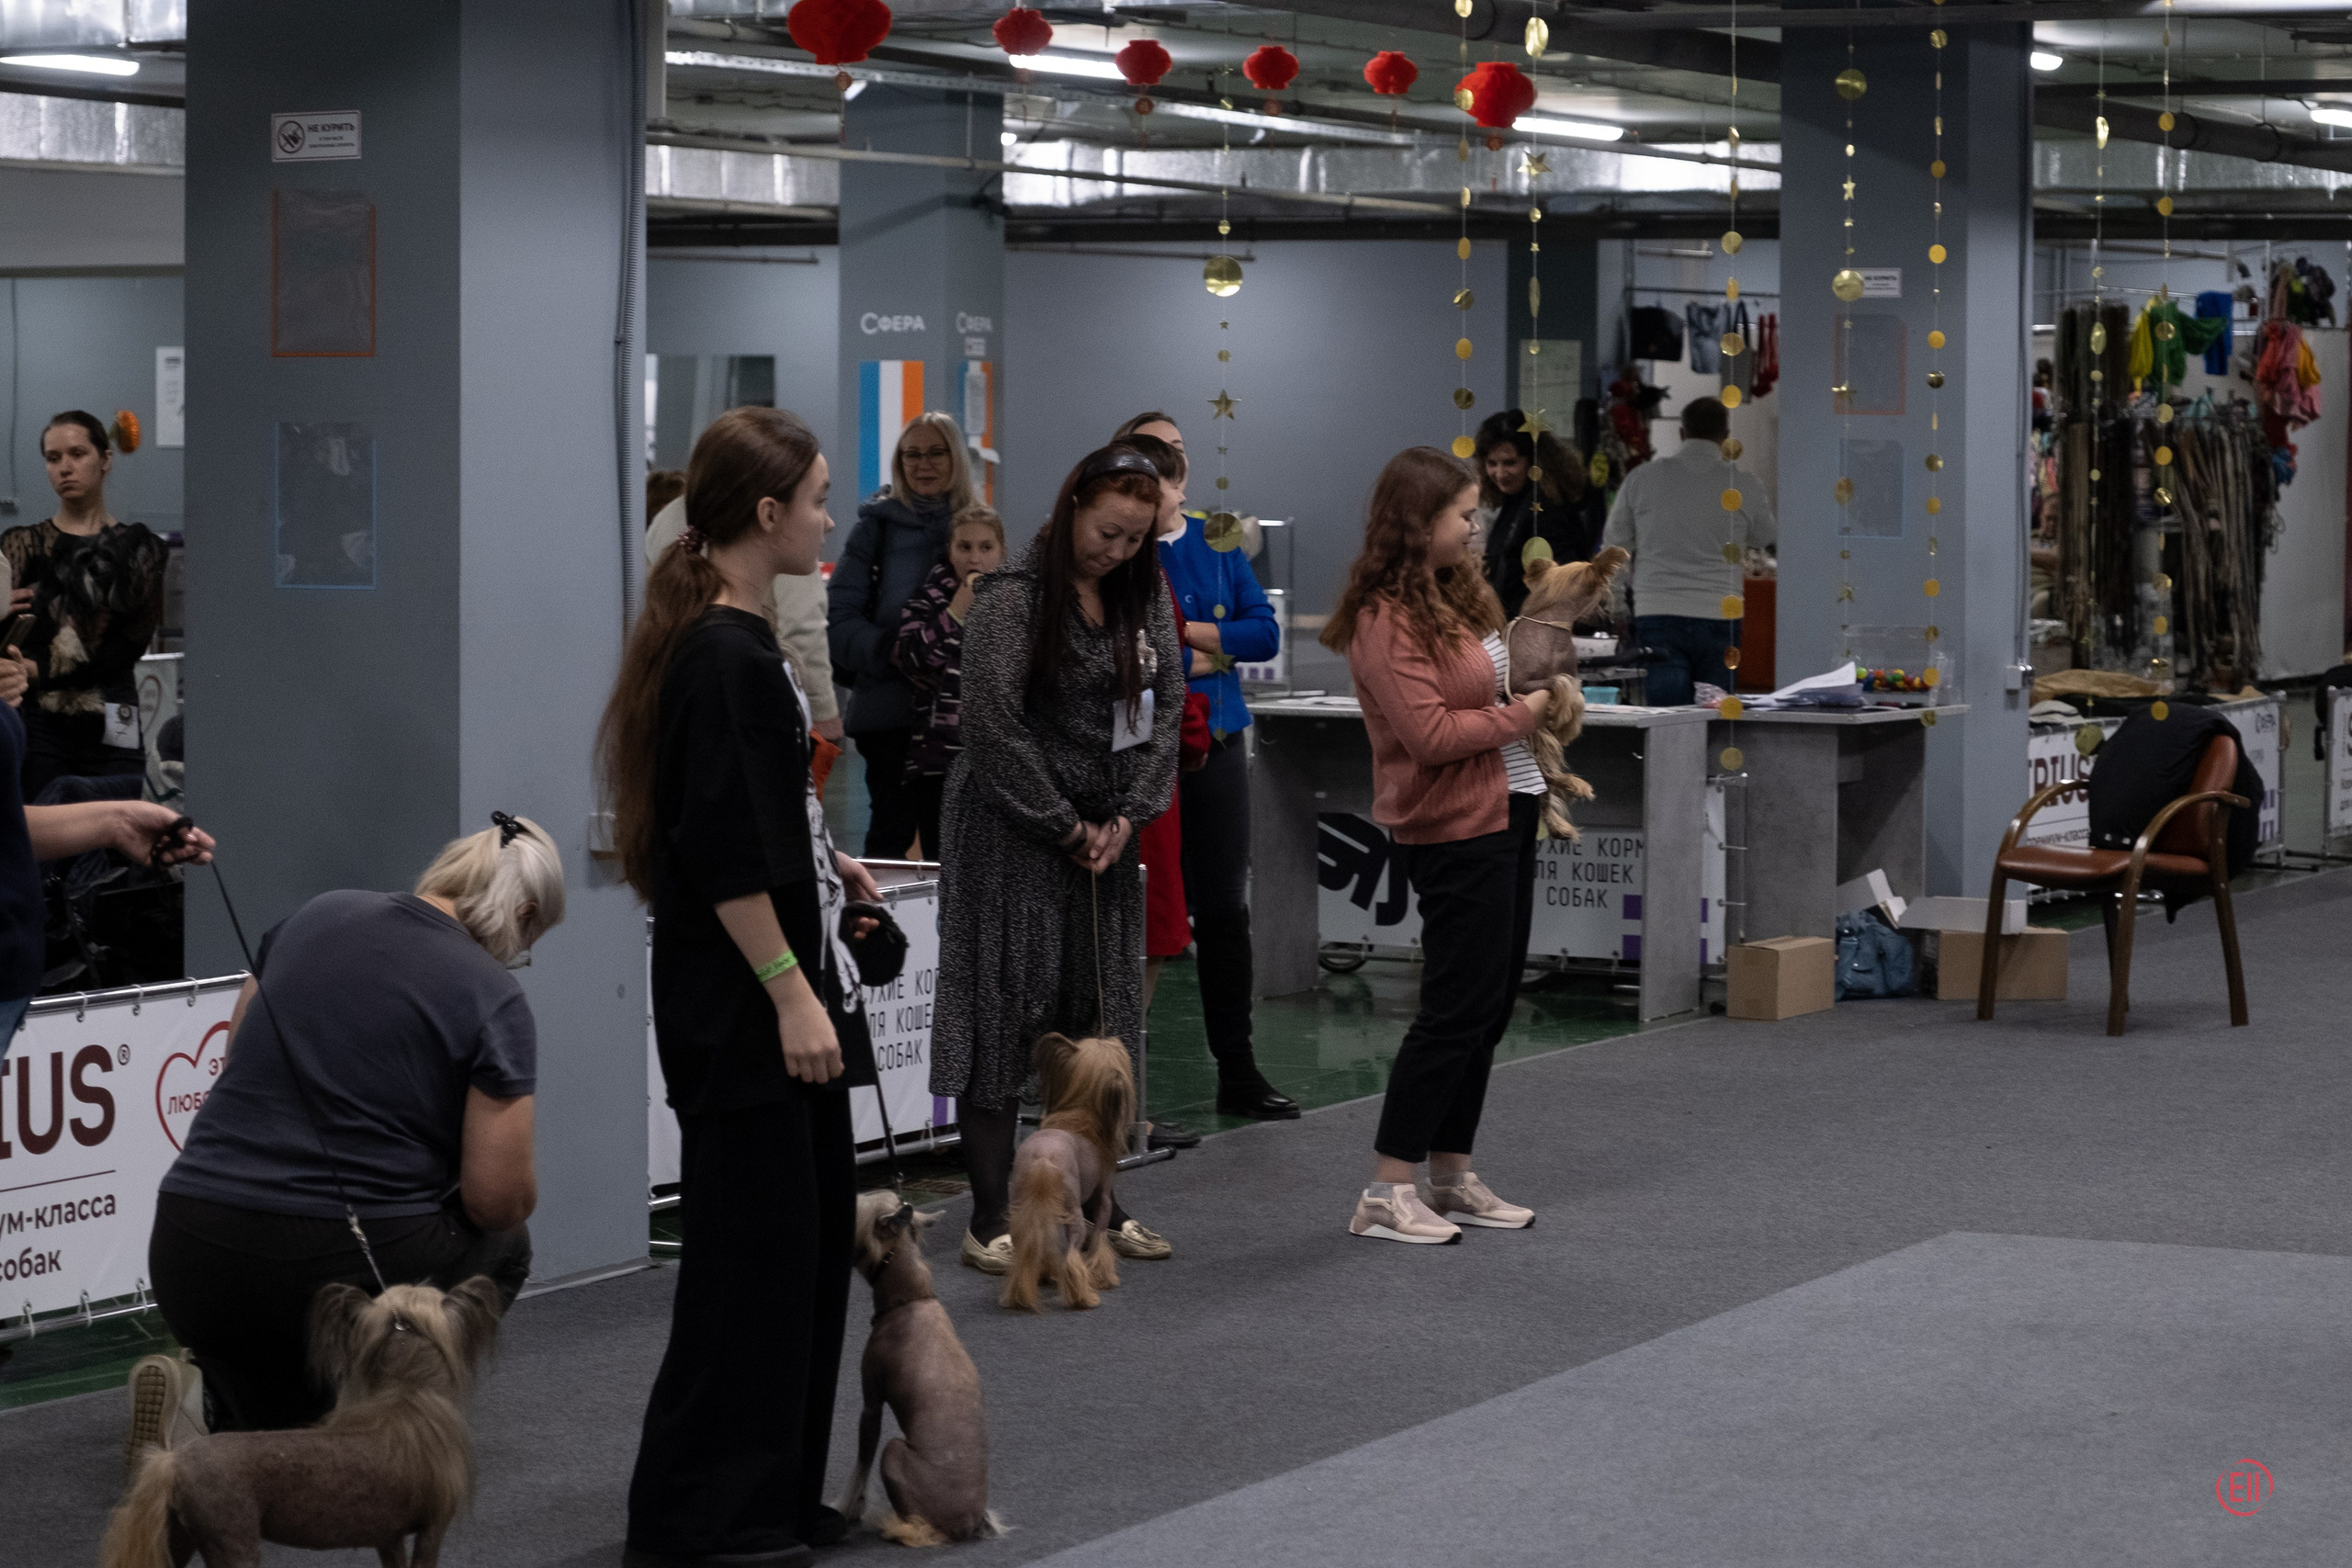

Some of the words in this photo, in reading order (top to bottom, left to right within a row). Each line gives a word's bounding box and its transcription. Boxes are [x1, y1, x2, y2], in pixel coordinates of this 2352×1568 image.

[1572, 862, 1634, 884] КОШЕК
[1546, 886, 1608, 908] СОБАК
[877, 1038, 923, 1072] СОБАК
